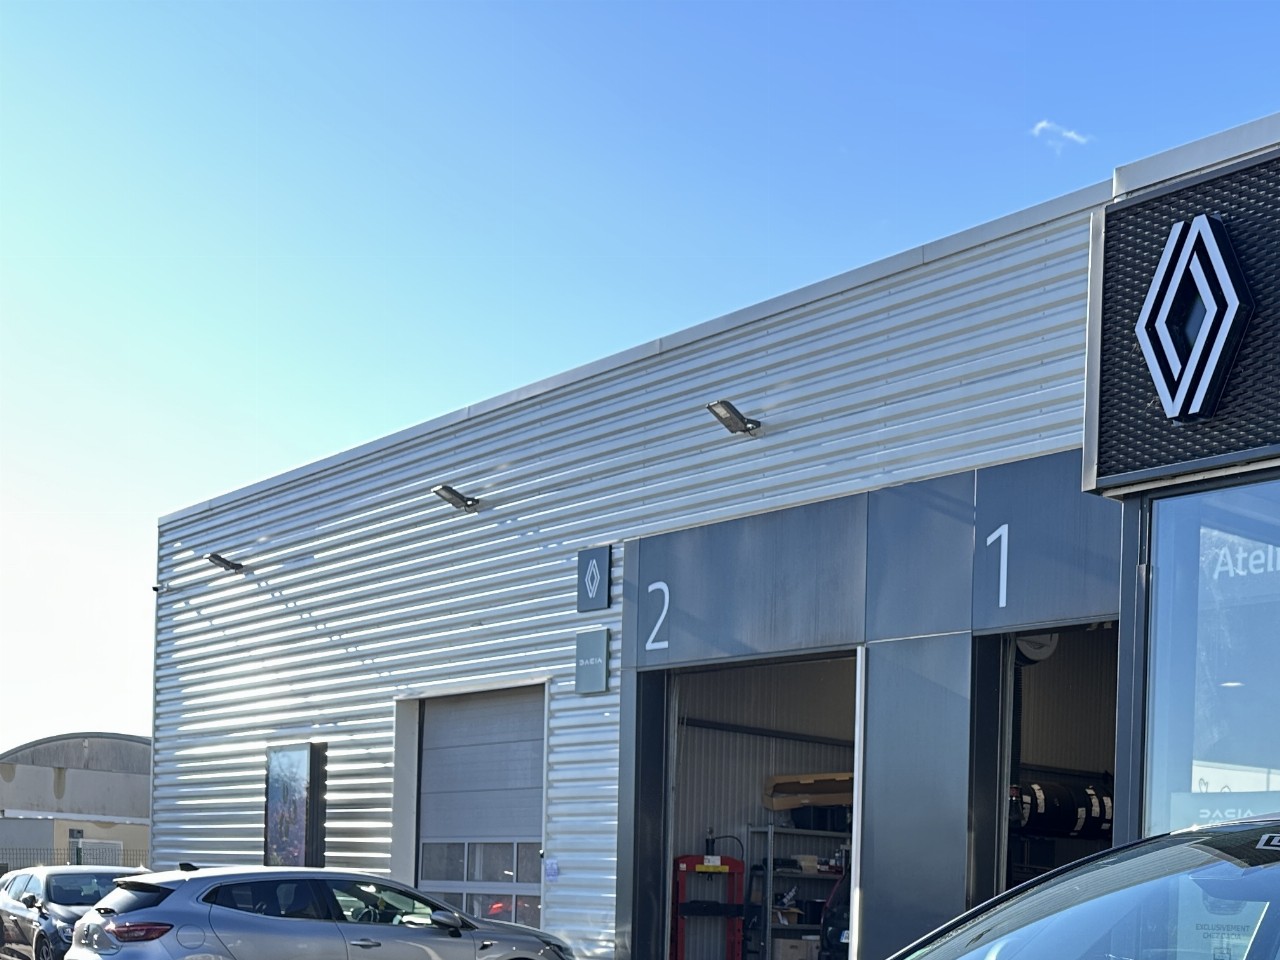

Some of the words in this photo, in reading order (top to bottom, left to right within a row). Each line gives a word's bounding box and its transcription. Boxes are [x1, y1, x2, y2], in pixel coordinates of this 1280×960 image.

[985, 523, 1010, 608] 1
[645, 581, 670, 651] 2
[1196, 923, 1251, 932] EXCLUSIVEMENT
